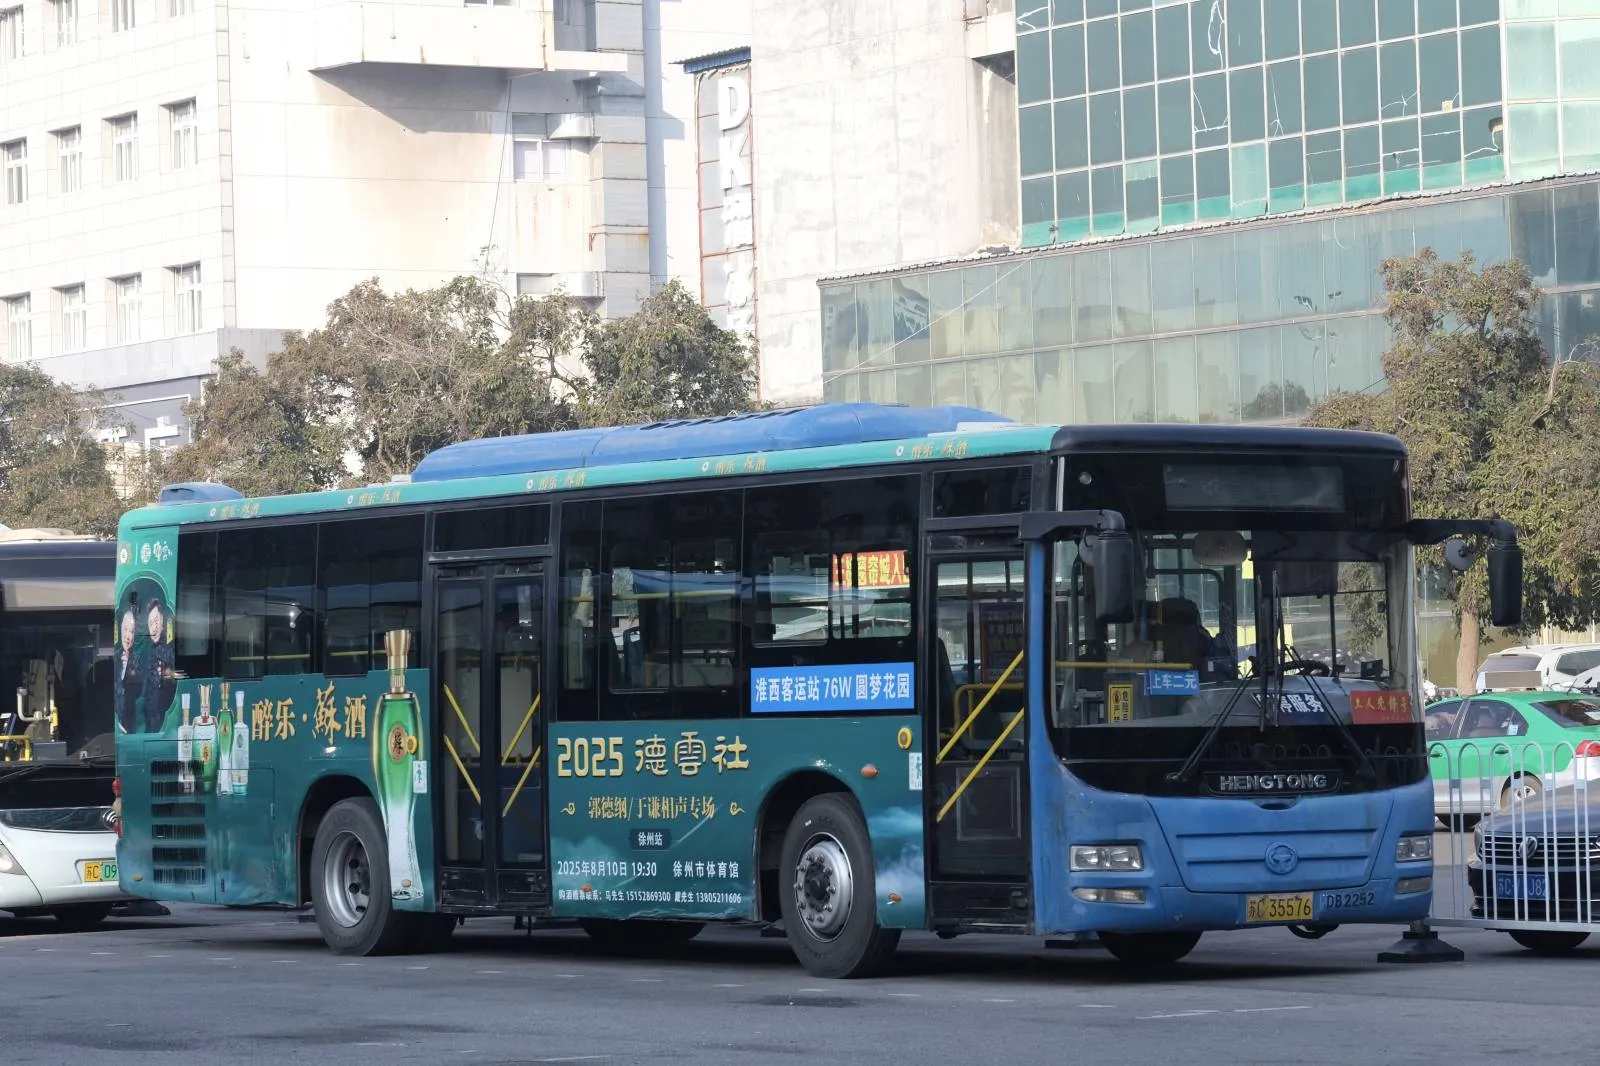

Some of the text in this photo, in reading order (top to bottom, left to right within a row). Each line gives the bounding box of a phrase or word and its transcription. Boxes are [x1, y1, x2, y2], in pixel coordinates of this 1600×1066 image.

[755, 672, 911, 703] 淮西客运站 76W 圆梦花园
[1152, 674, 1197, 689] 上车二元
[557, 737, 623, 777] 2025
[1220, 774, 1327, 791] HENGTONG
[638, 831, 663, 847] 徐州站
[557, 860, 739, 879] 2025年8月10日 19:30 徐州市体育馆
[696, 892, 742, 904] 13805211606
[1326, 892, 1375, 908] DB2252
